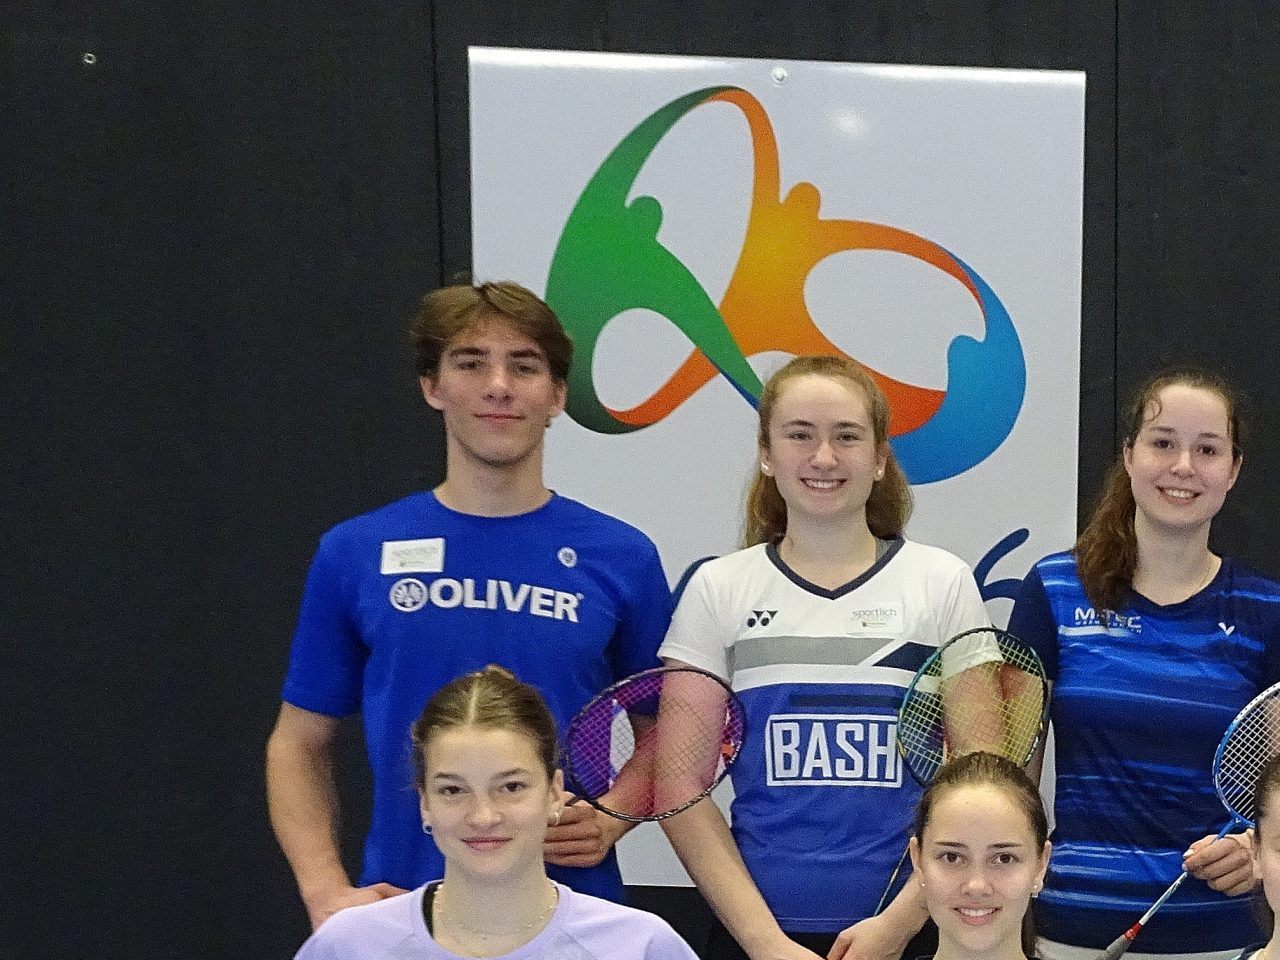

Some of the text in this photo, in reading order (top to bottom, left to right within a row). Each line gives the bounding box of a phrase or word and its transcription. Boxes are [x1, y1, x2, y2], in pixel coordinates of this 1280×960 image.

[429, 578, 580, 623] OLIVER
[852, 607, 897, 618] sportlich
[772, 722, 897, 780] BASH
